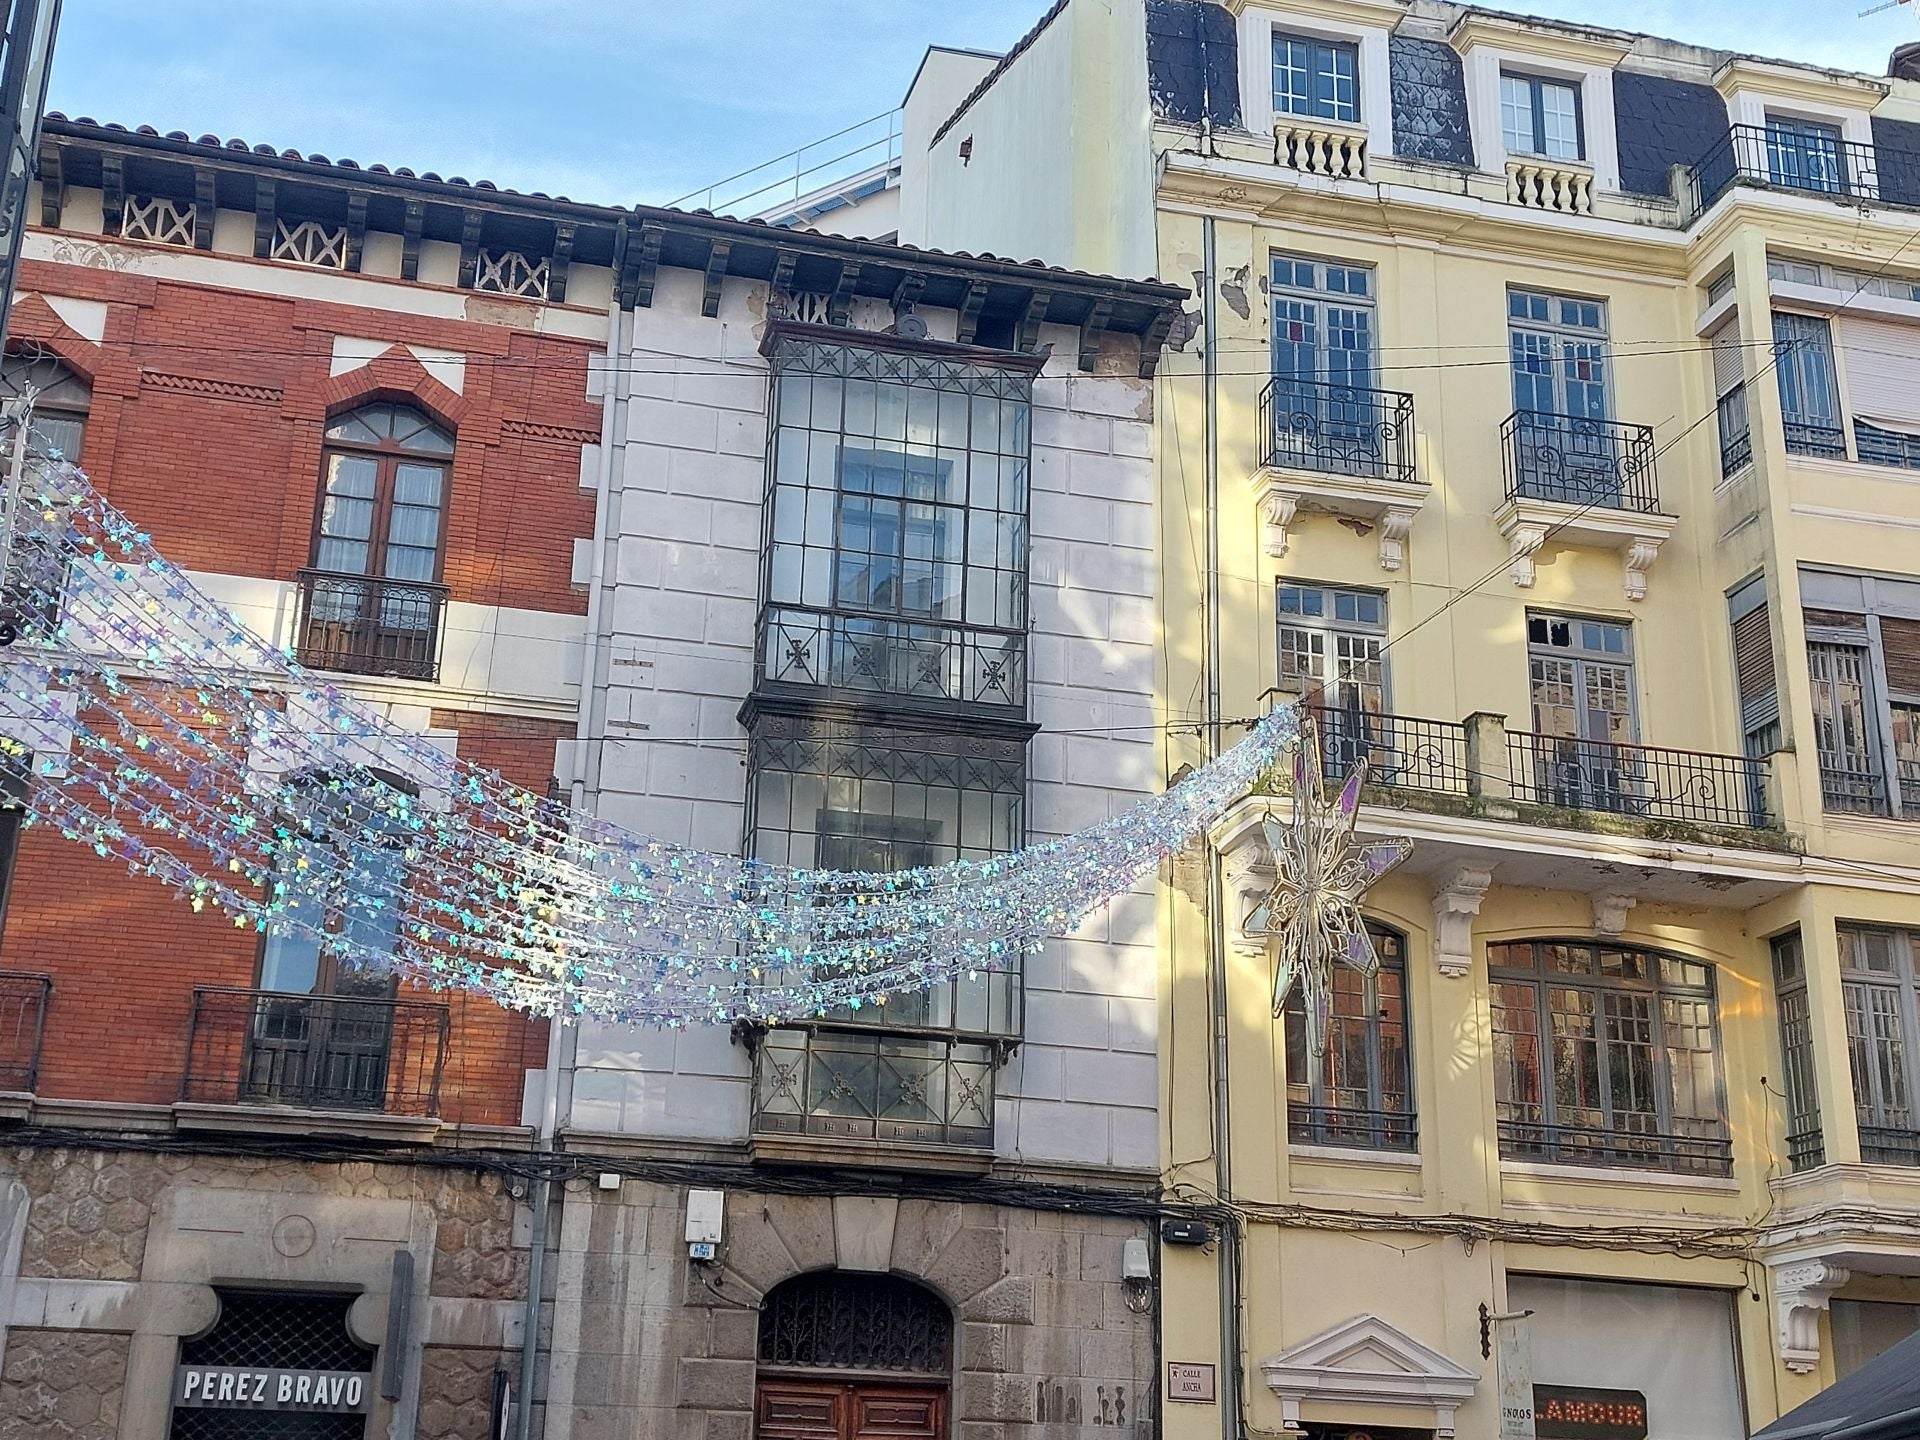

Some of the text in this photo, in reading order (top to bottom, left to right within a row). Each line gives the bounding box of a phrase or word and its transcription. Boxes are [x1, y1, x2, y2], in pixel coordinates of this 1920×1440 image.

[1182, 1369, 1201, 1379] CALLE
[183, 1371, 362, 1406] PEREZ BRAVO
[1182, 1382, 1201, 1392] ANCHA
